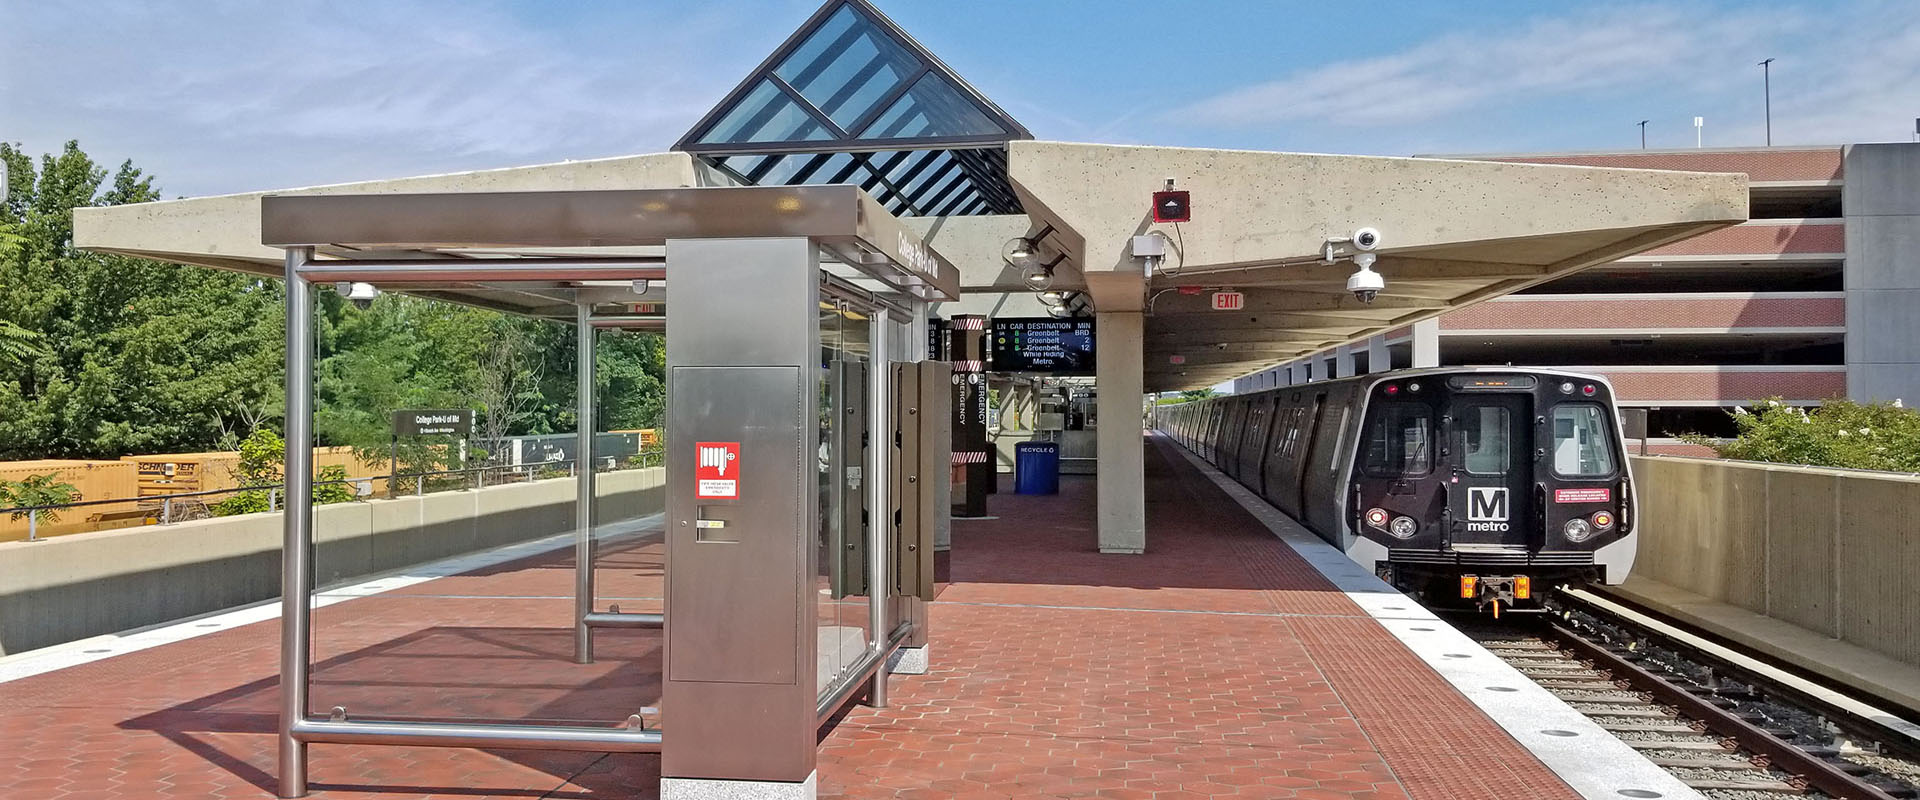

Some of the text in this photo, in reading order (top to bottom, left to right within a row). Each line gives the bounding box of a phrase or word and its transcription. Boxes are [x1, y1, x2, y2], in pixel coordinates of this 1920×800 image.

[898, 230, 915, 267] College
[1217, 294, 1239, 308] EXIT
[416, 415, 432, 425] College
[1471, 490, 1506, 518] M
[1467, 521, 1510, 532] metro
